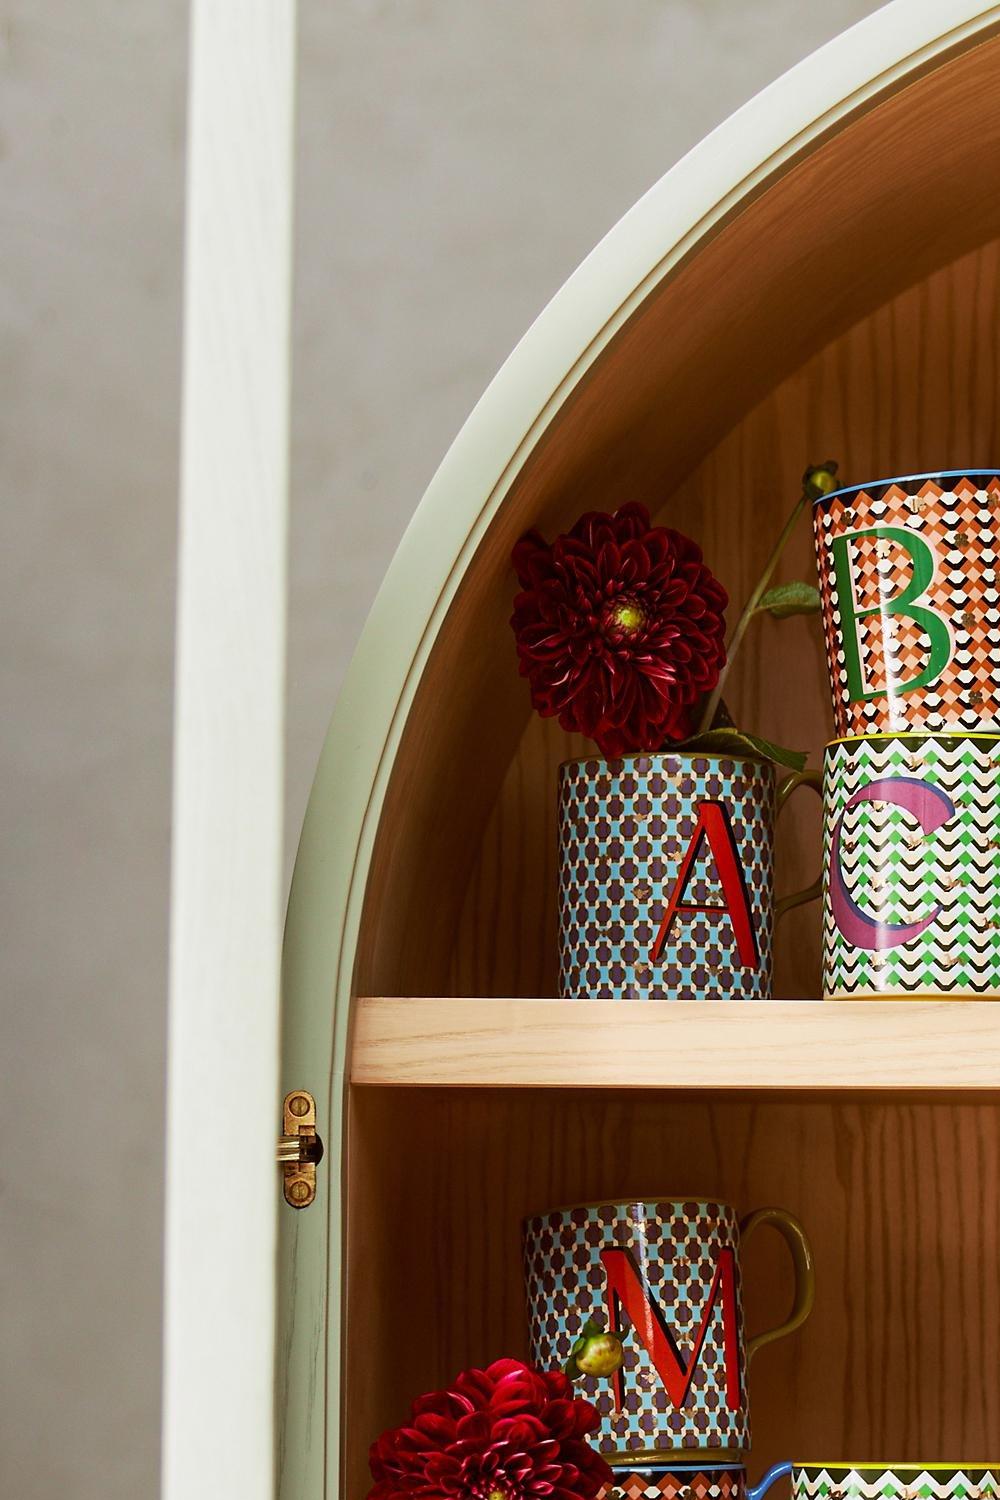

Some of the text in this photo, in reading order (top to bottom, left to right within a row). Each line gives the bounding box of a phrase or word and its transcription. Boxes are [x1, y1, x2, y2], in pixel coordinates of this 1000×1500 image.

[832, 527, 953, 702] B
[651, 800, 756, 967] A
[829, 776, 957, 950] C
[600, 1247, 740, 1414] M
